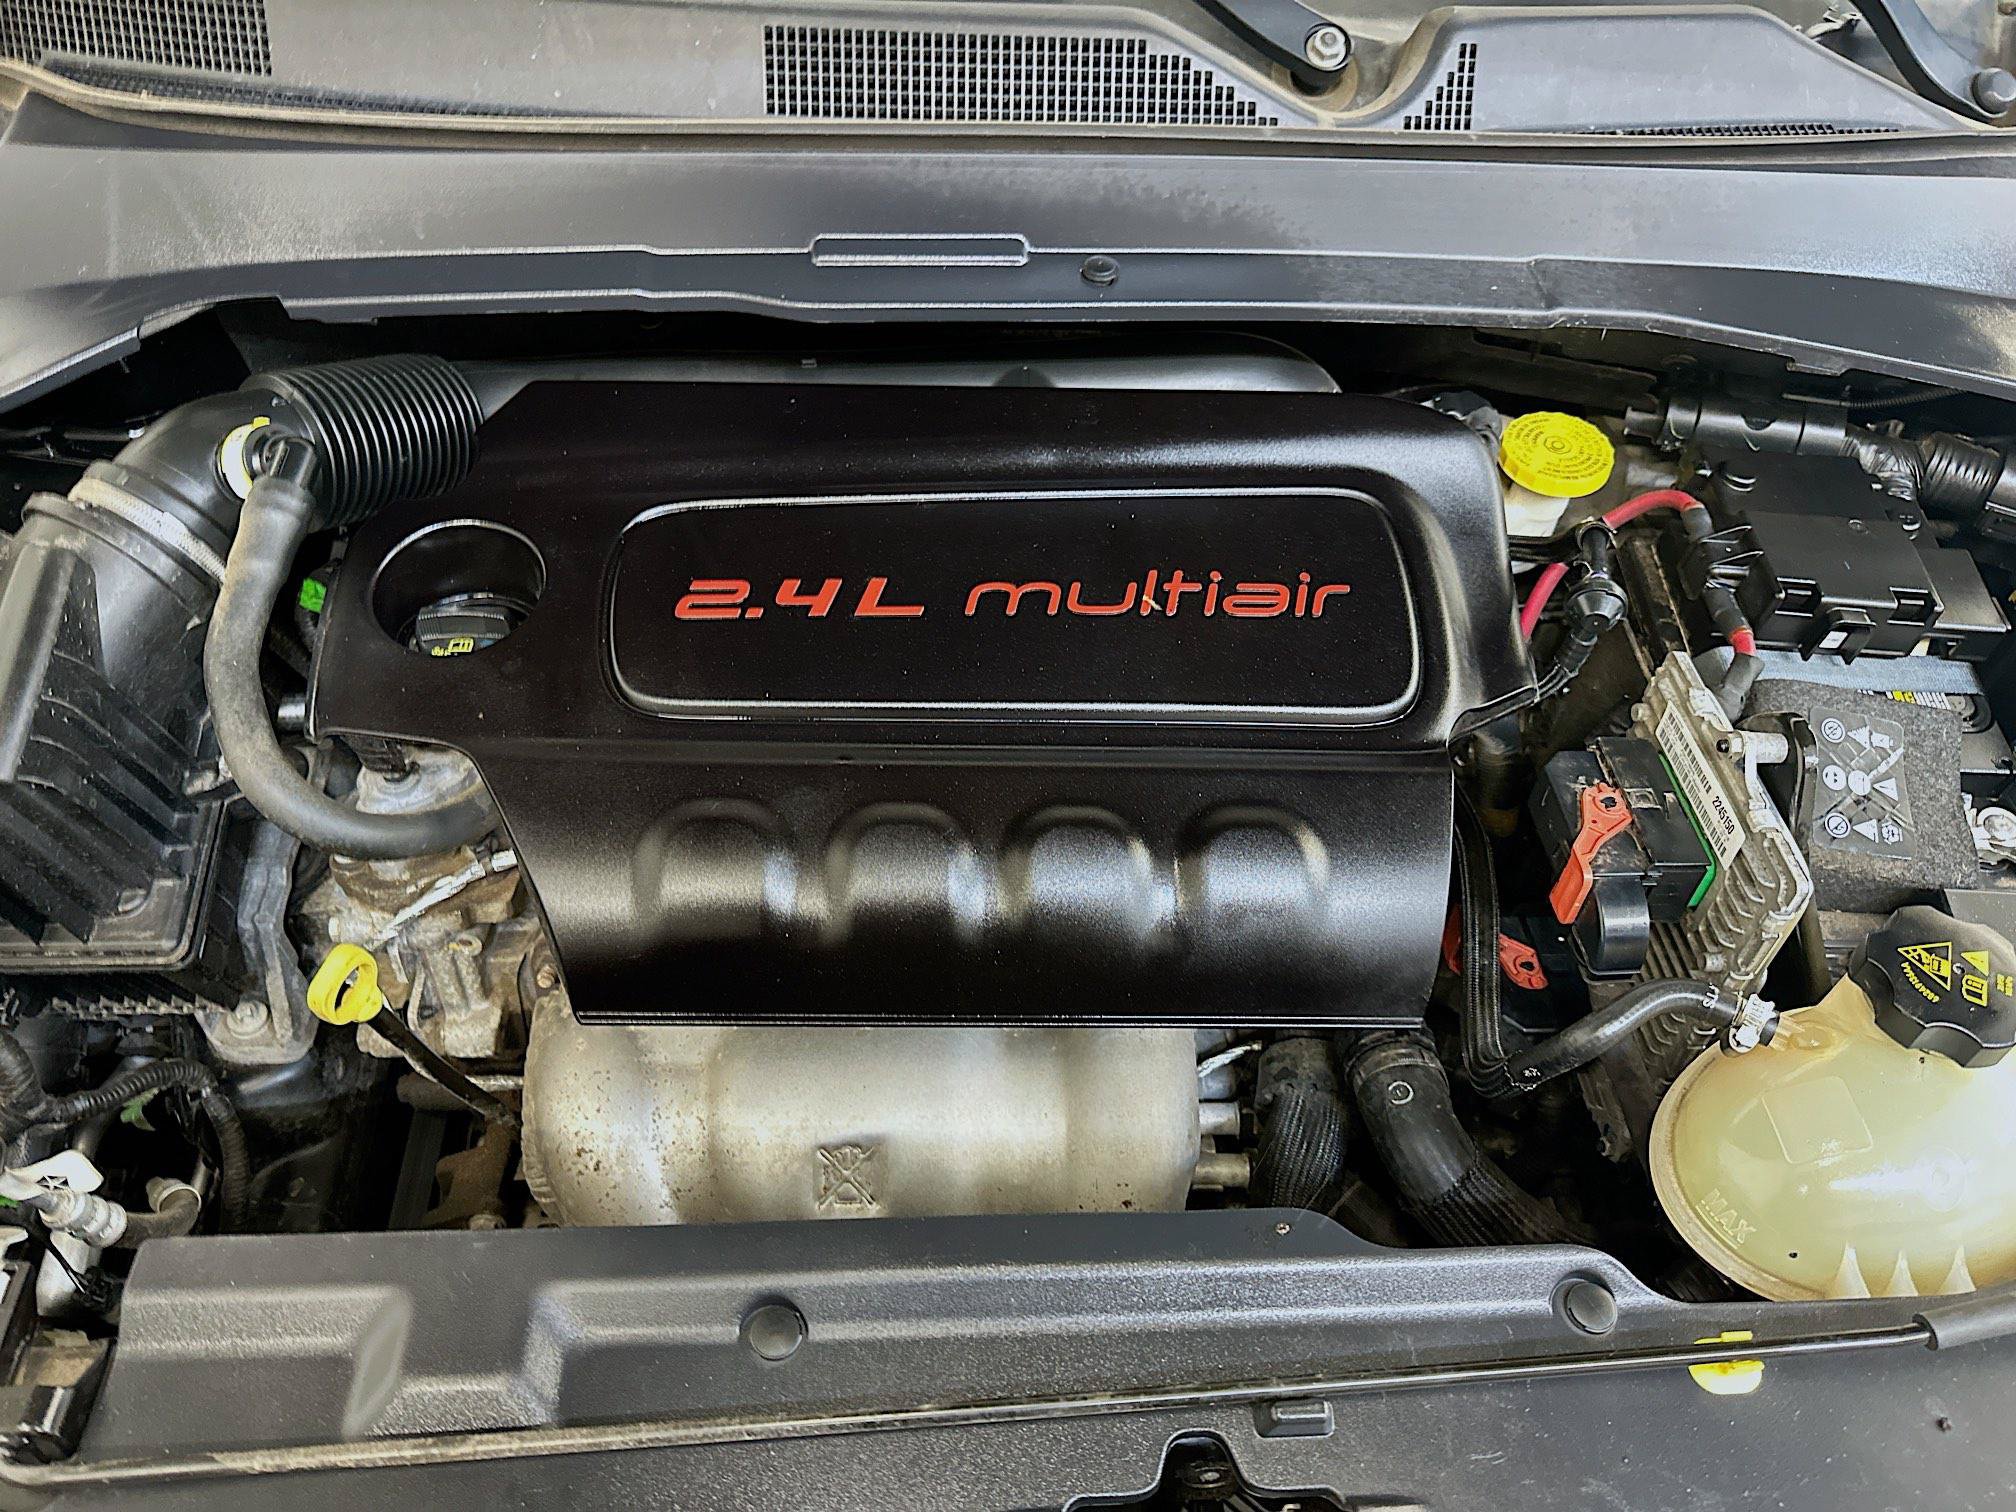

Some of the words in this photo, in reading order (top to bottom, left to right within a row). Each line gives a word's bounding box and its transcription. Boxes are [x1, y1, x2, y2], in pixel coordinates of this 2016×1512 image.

[674, 576, 925, 619] 2.4L
[964, 568, 1351, 618] multiair
[1711, 795, 1735, 836] 2245150
[1700, 1187, 1757, 1245] MAX
